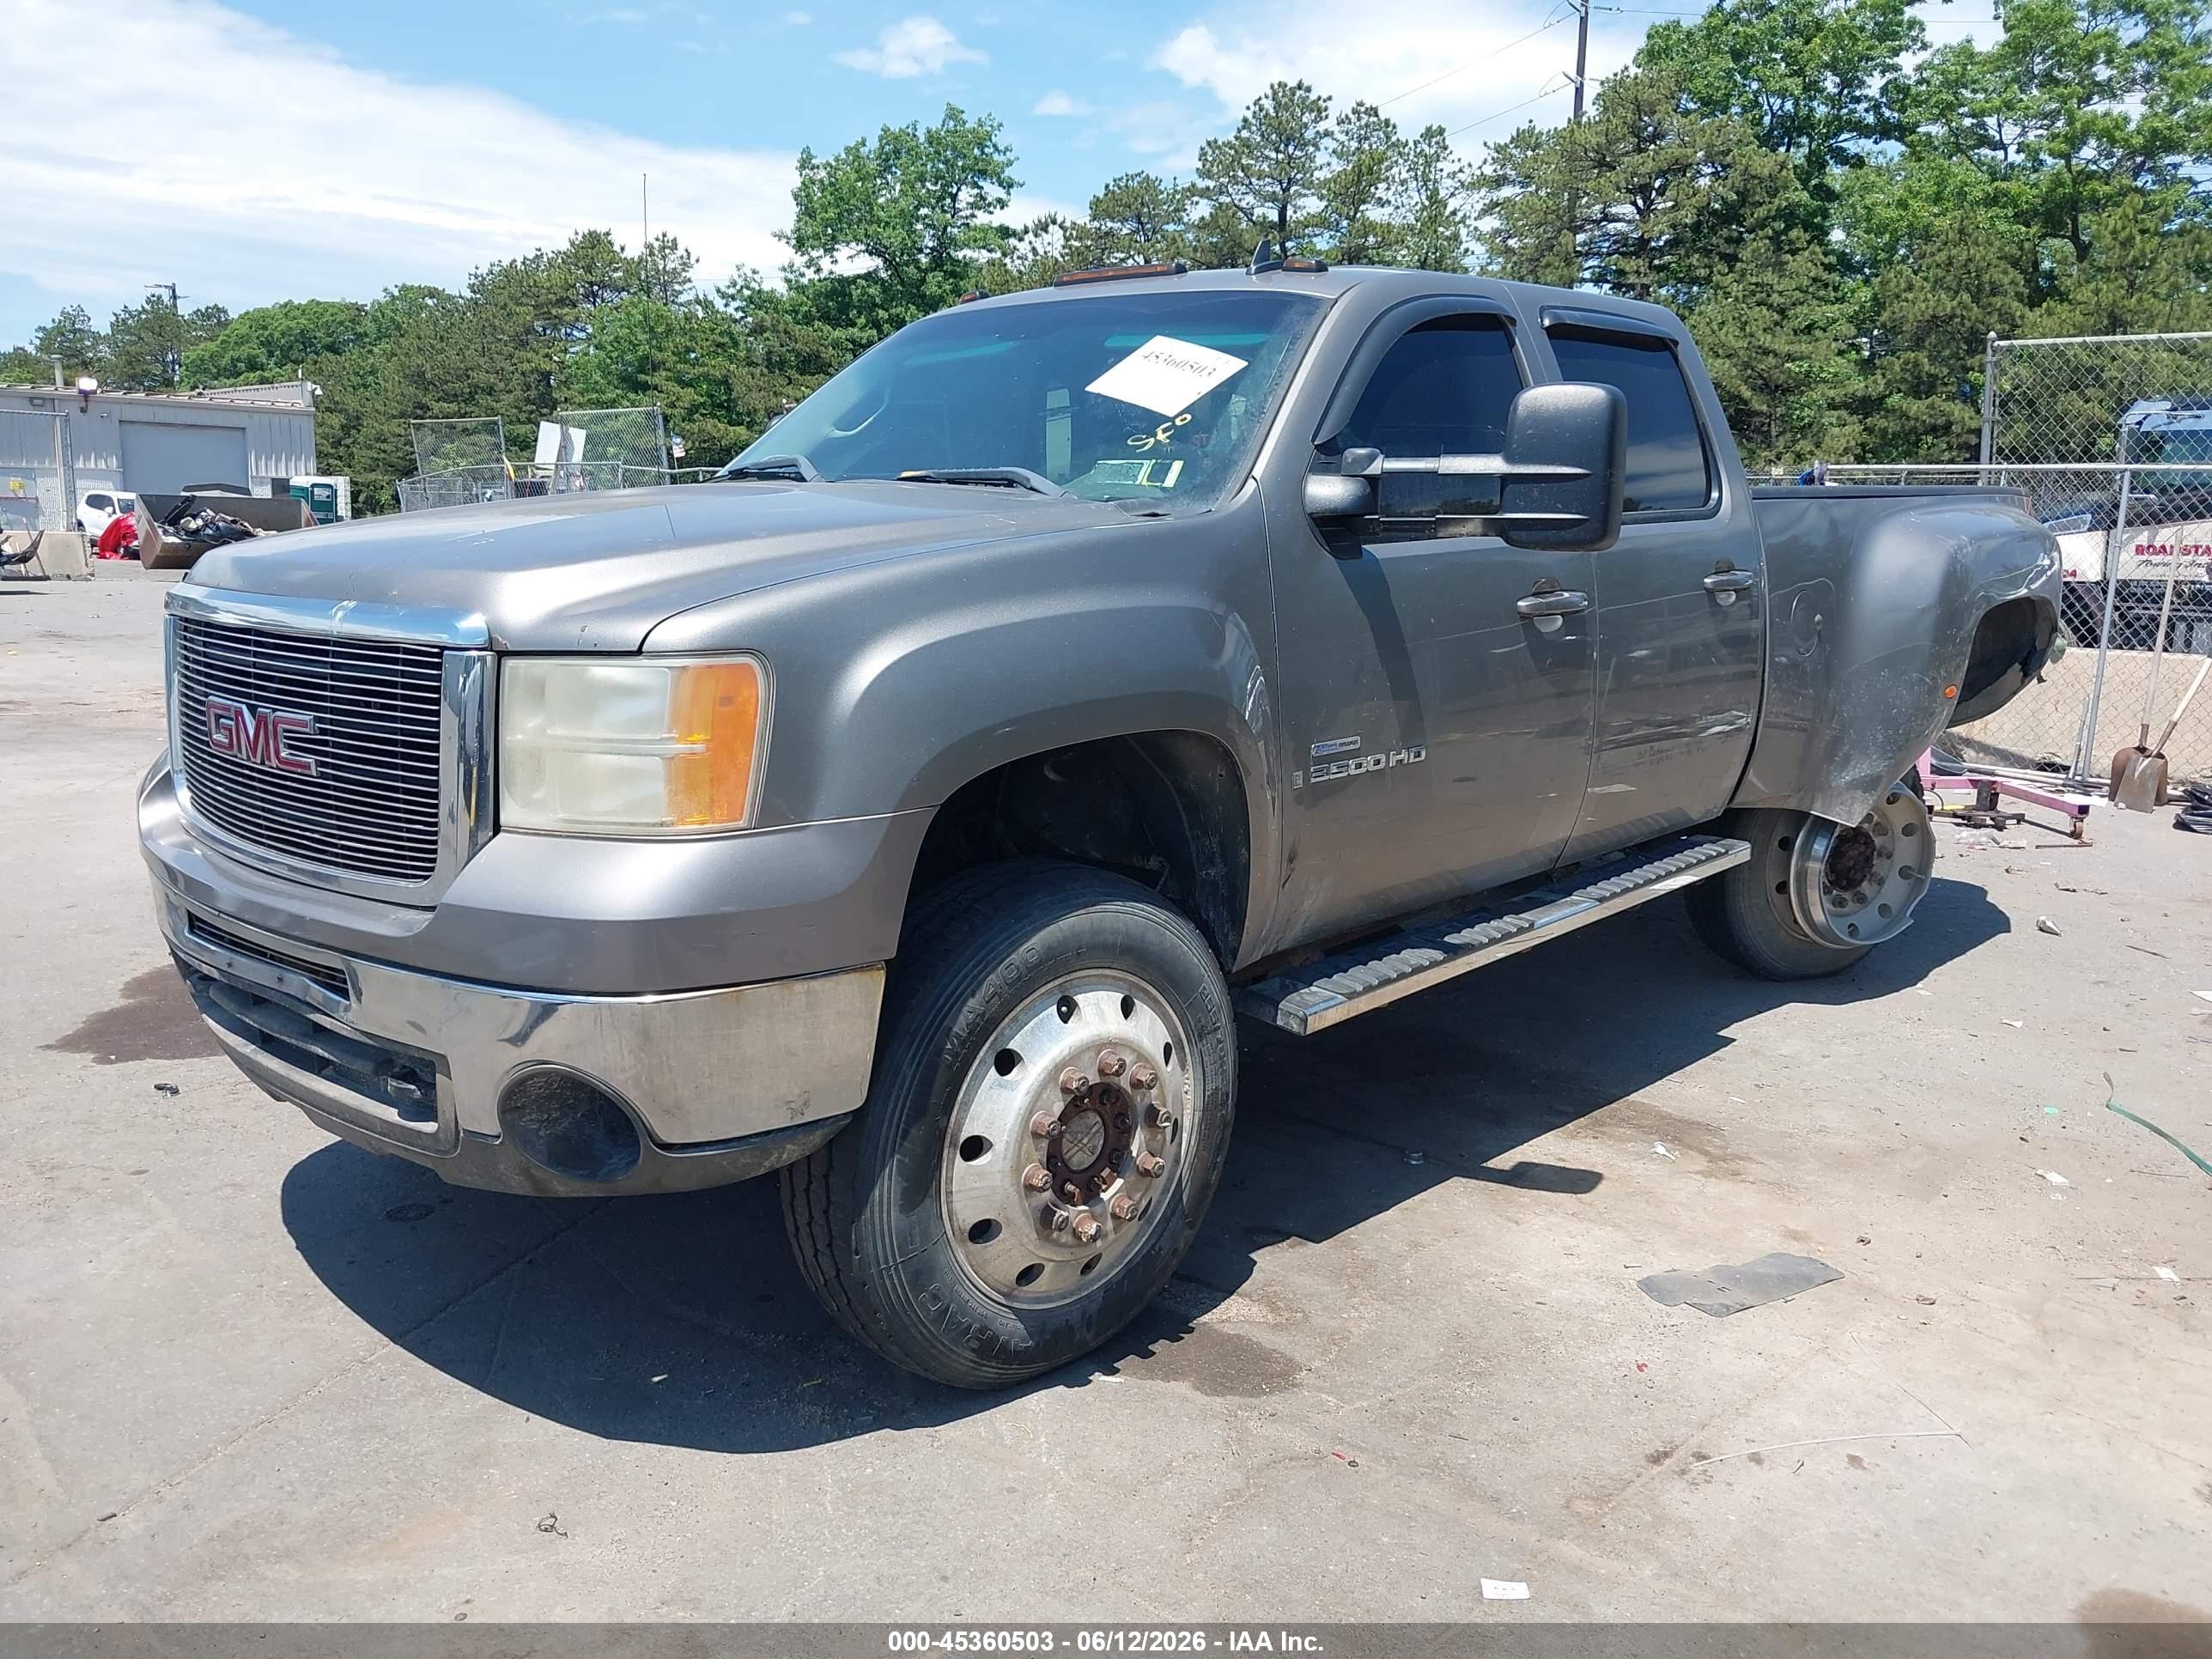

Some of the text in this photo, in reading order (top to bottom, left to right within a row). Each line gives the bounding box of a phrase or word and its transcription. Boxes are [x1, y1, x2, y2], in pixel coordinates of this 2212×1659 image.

[205, 695, 318, 777] GMC
[1310, 753, 1387, 784] 3500
[1389, 744, 1427, 768] HD
